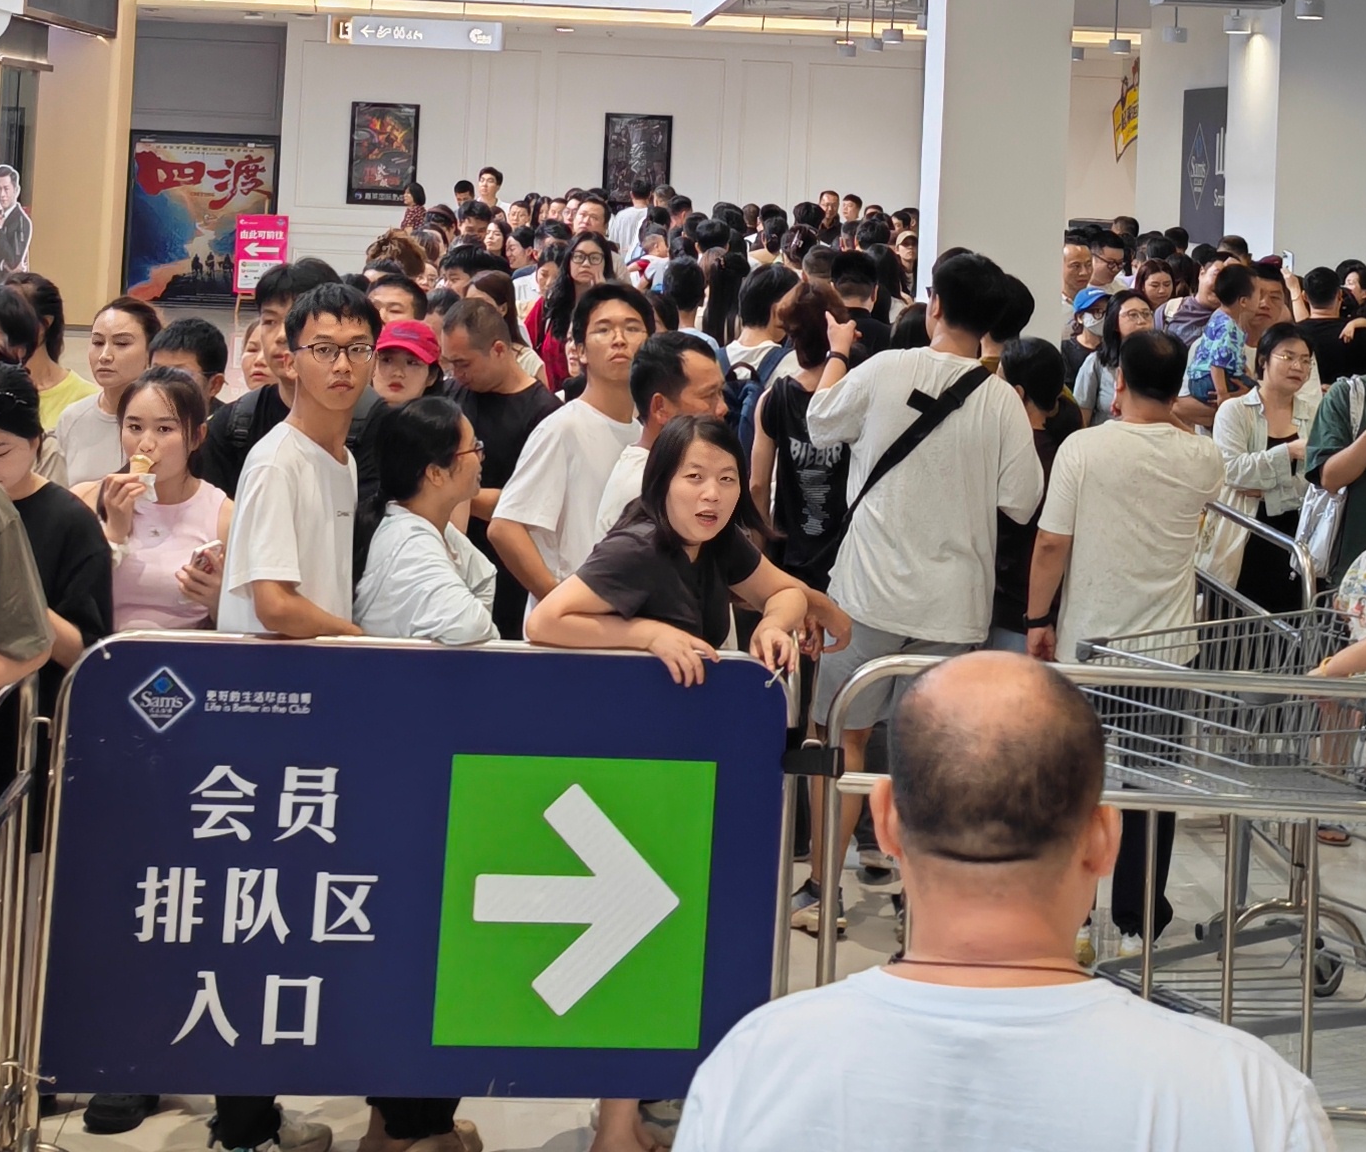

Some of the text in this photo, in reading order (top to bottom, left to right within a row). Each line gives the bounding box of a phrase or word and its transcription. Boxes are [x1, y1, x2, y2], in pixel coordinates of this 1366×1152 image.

[135, 151, 272, 210] 四渡
[240, 230, 284, 240] 由此可前往
[789, 436, 843, 468] BIEBER
[140, 690, 184, 708] Sam's
[204, 702, 221, 712] Life
[288, 704, 311, 715] Club
[189, 764, 340, 844] 会员
[133, 866, 380, 945] 排队区
[169, 970, 324, 1048] 入口
